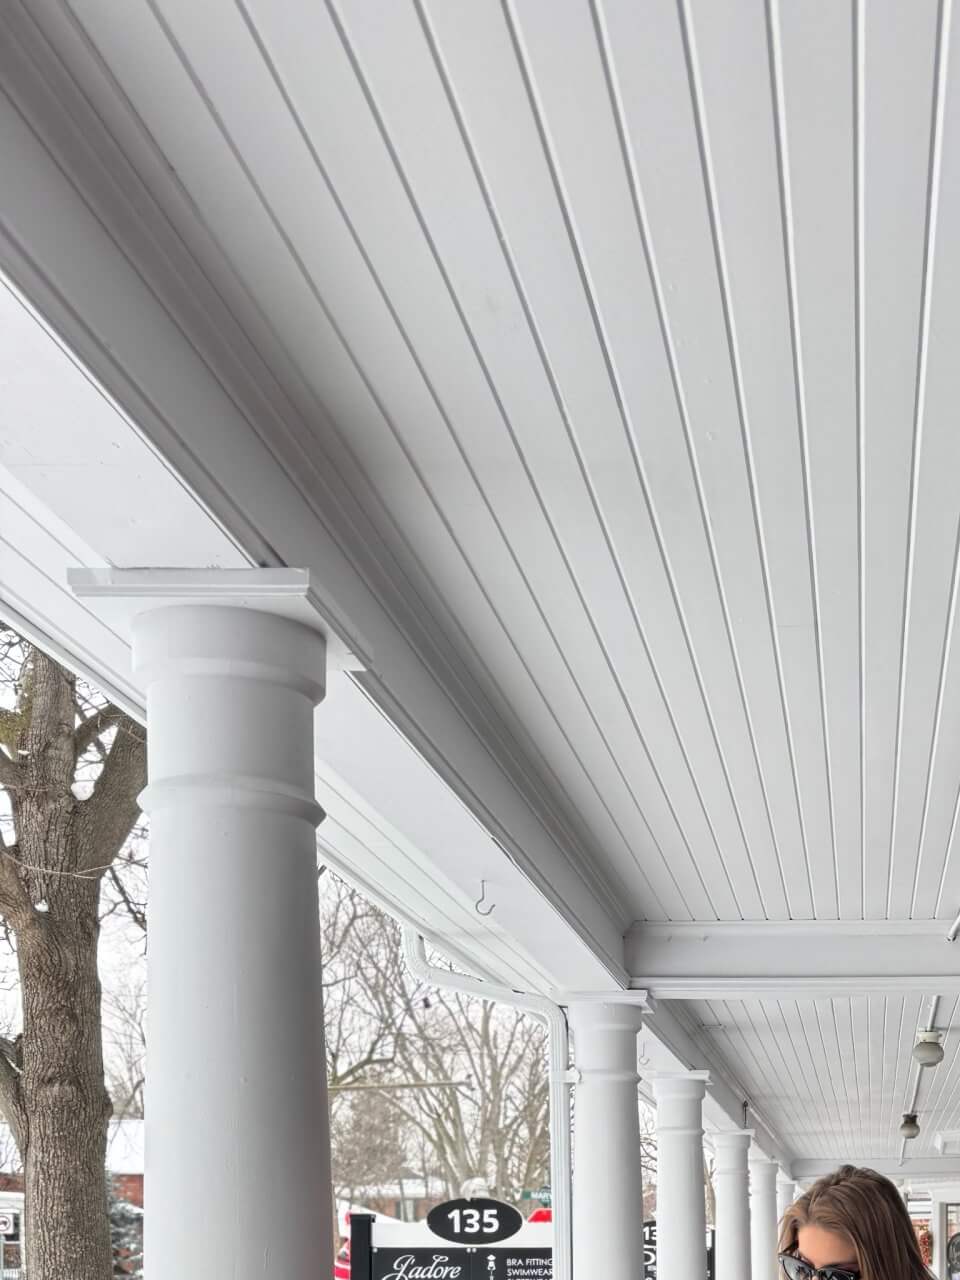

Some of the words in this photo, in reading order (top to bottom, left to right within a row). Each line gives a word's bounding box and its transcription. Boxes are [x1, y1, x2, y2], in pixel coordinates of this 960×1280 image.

[447, 1209, 500, 1234] 135
[506, 1258, 524, 1266] BRA
[506, 1268, 553, 1277] SWIMWEAR
